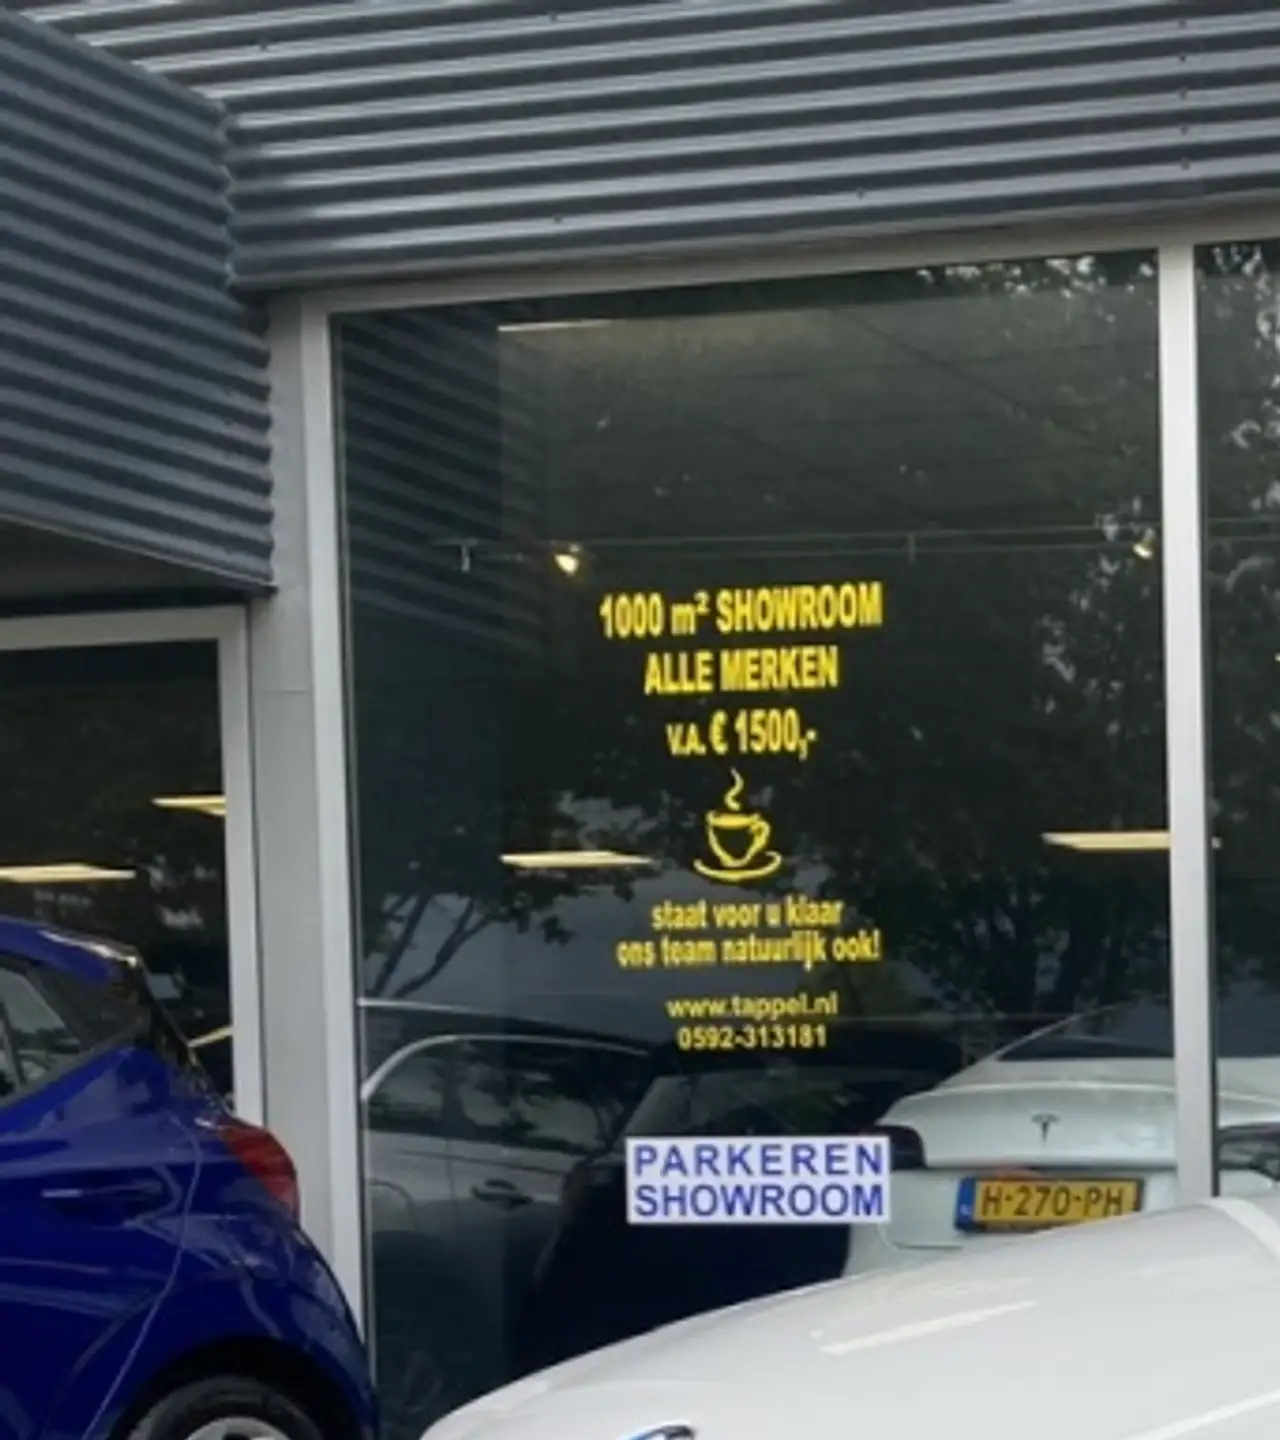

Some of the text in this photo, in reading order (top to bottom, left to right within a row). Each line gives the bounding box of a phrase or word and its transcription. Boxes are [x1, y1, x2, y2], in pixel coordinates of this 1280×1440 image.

[600, 591, 664, 639] 1000
[715, 581, 883, 633] SHOWROOM
[644, 645, 839, 695] ALLE MERKEN
[709, 709, 729, 755] €
[651, 896, 844, 930] staat voor u klaar
[616, 929, 881, 970] ons team natuurlijk ook!
[665, 992, 839, 1021] www.tappel.nl
[677, 1024, 827, 1050] 0592-313181
[634, 1144, 883, 1178] PARKEREN
[633, 1184, 885, 1219] SHOWROOM
